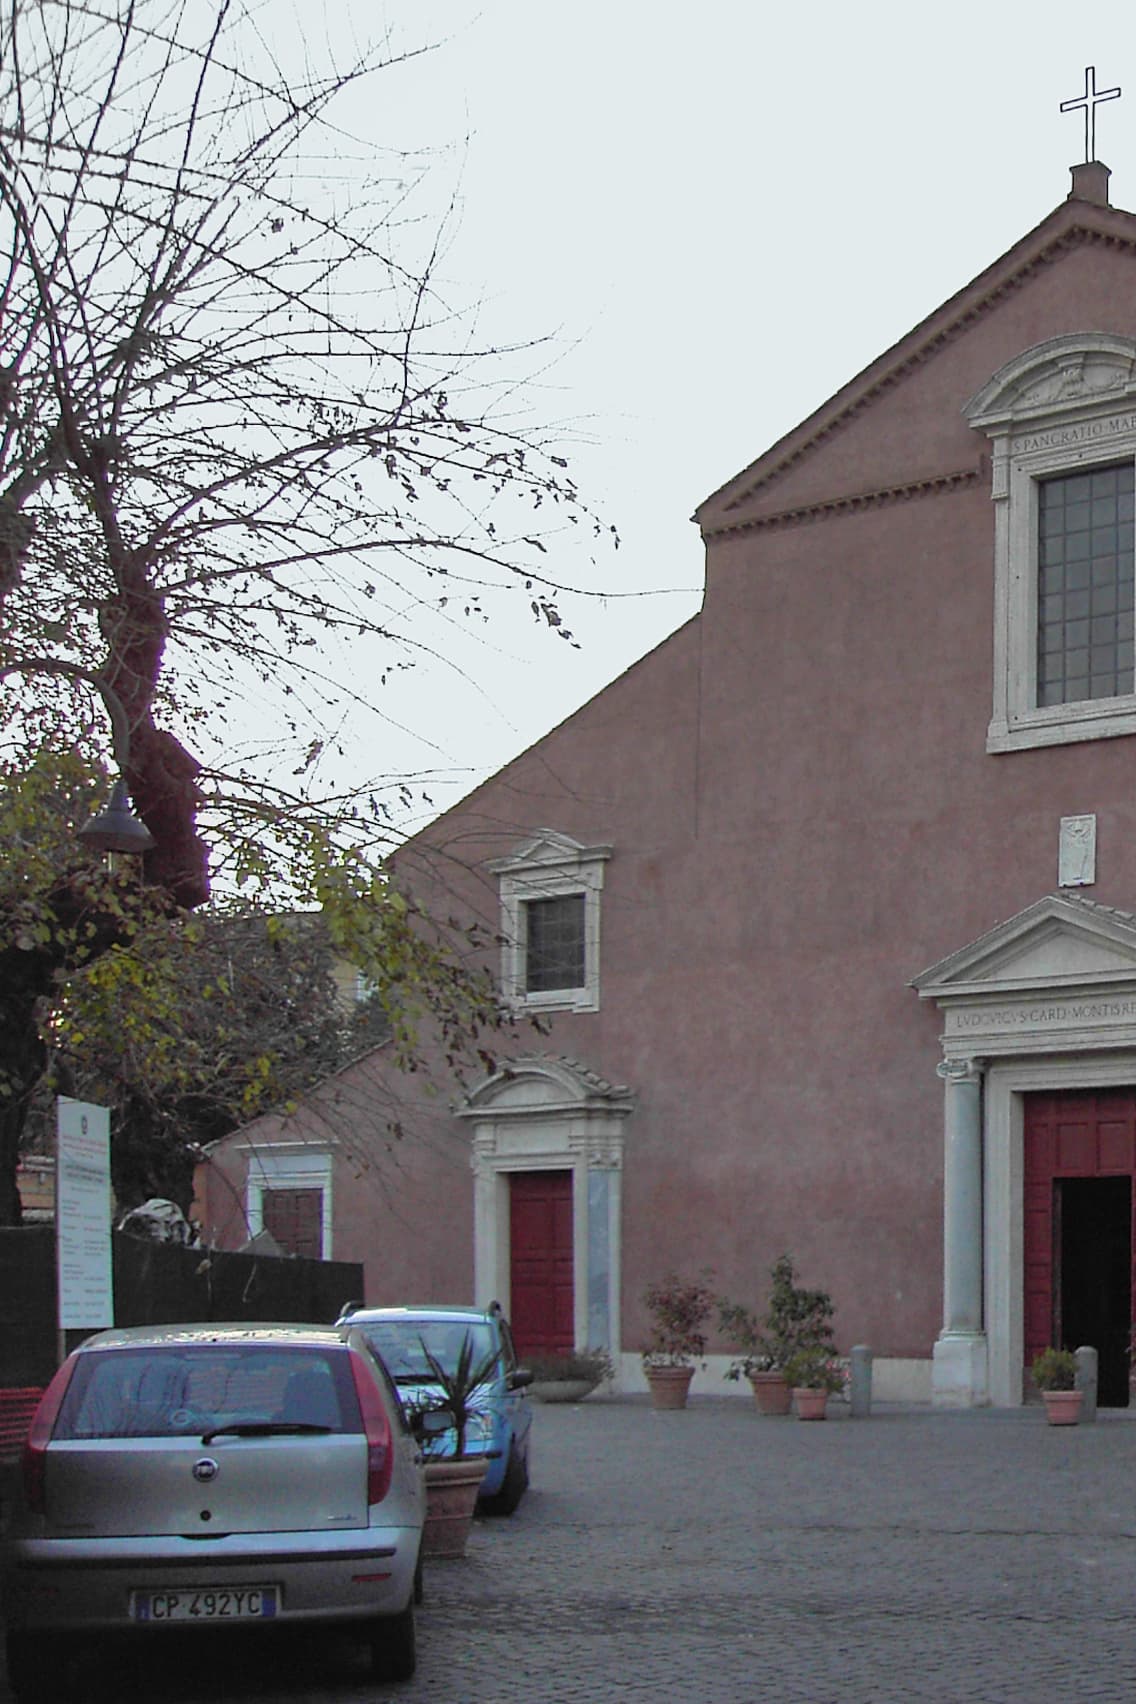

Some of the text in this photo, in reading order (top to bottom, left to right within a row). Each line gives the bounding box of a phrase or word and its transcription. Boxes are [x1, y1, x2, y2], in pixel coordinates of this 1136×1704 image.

[1024, 424, 1103, 450] PANCRATIO
[152, 1592, 260, 1619] CP 492YC
